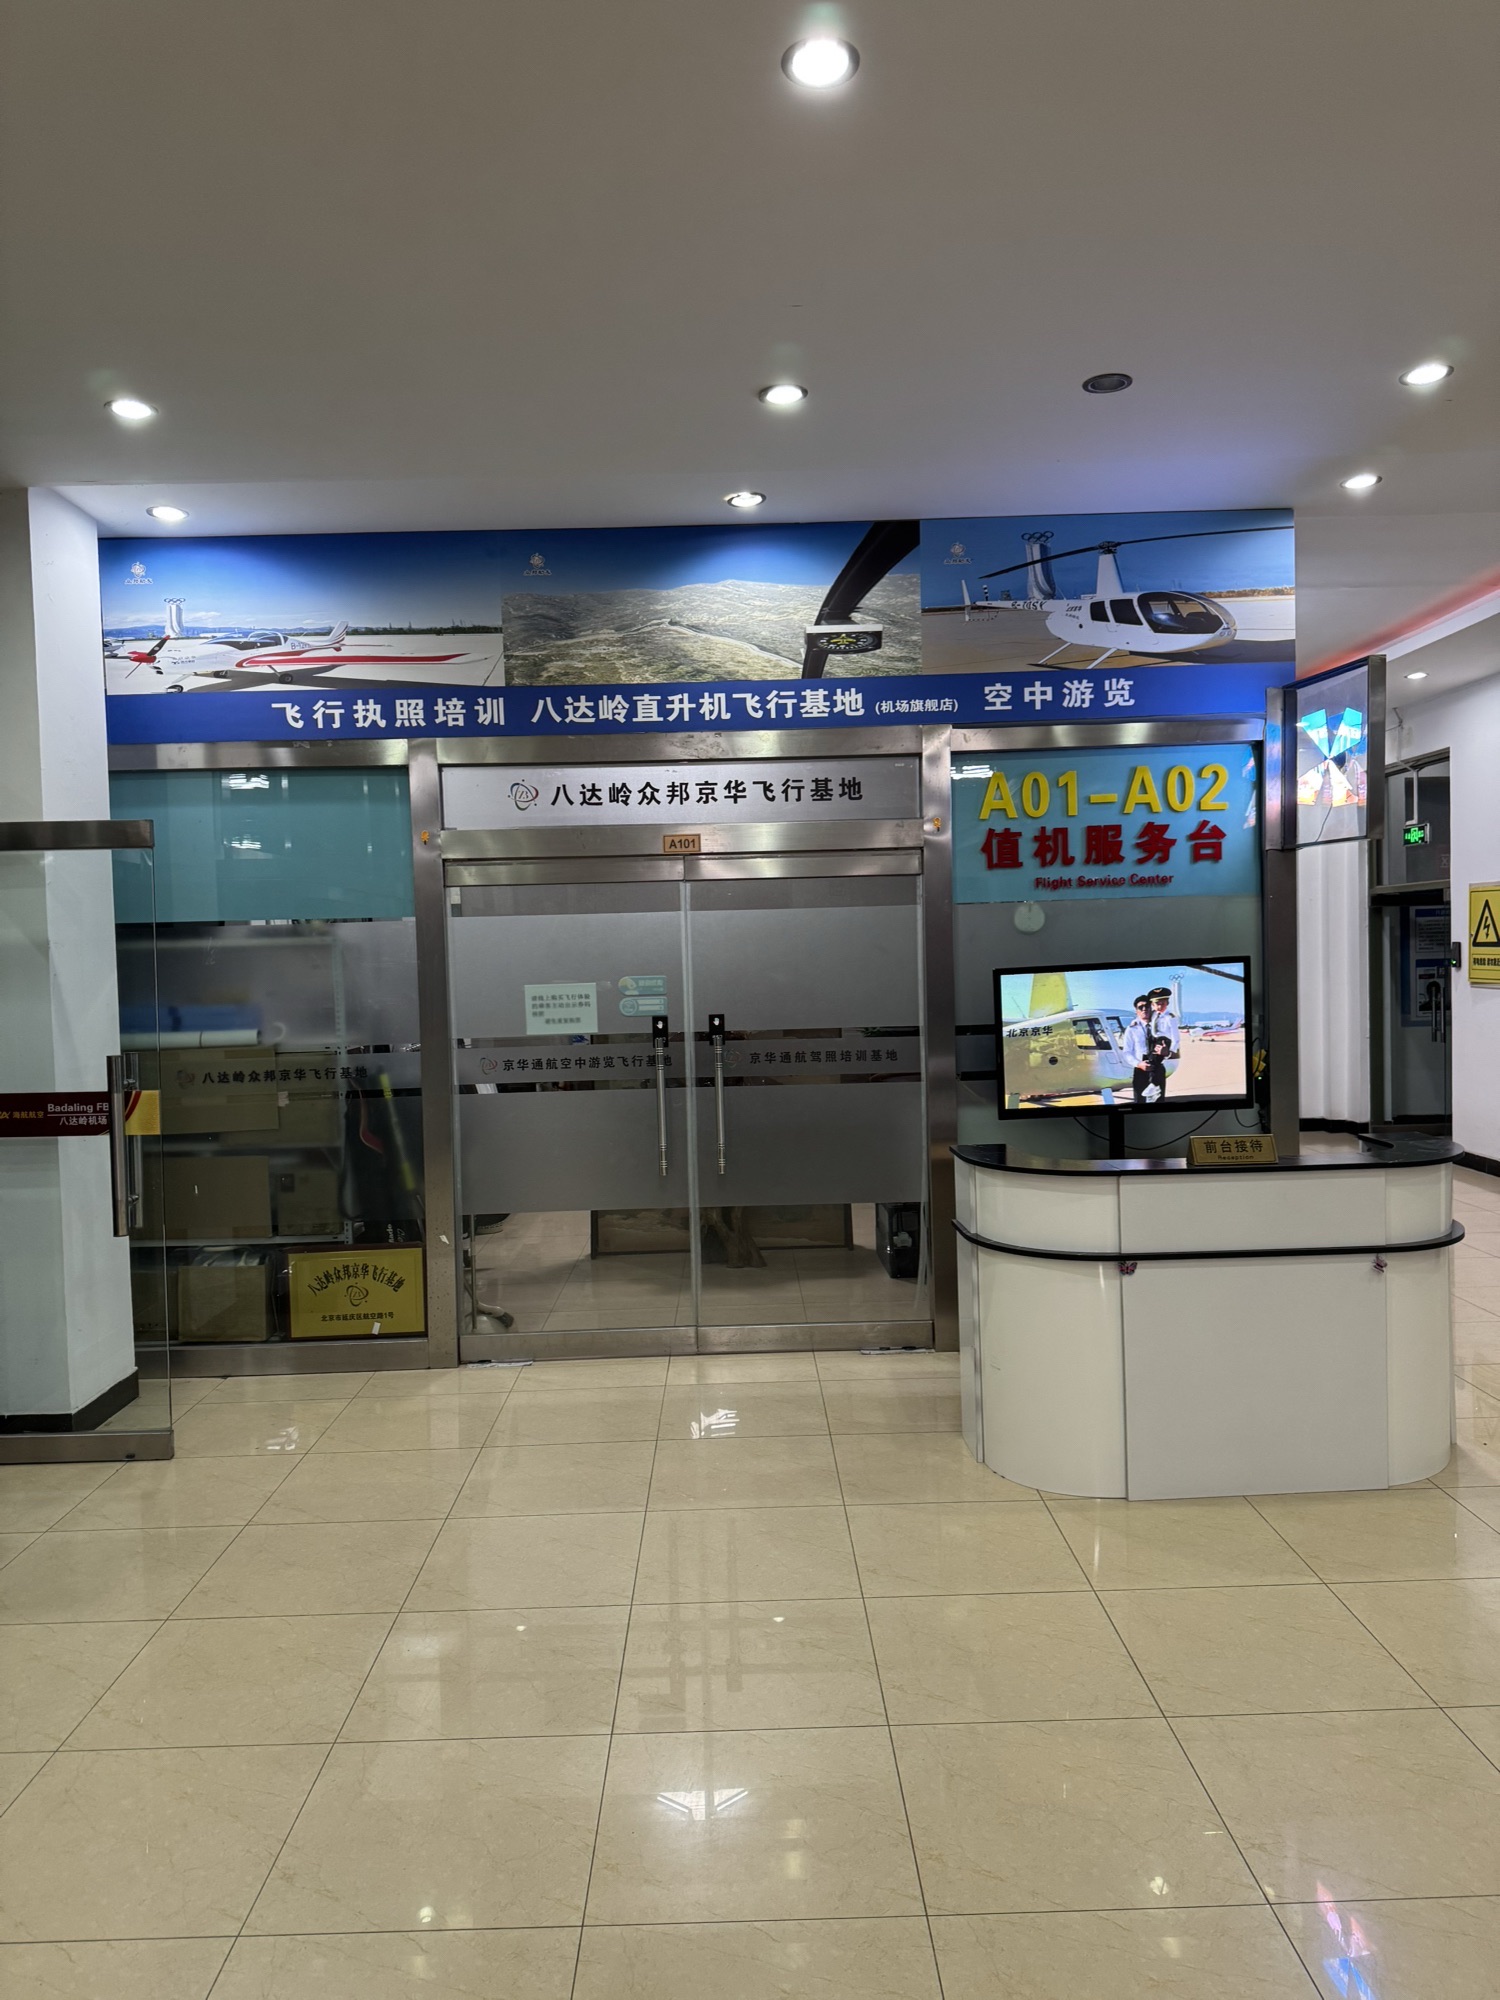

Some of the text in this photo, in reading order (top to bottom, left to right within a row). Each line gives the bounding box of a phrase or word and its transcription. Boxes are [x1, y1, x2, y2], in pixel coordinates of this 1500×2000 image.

[271, 678, 1136, 729] 飞行执照培训 八达岭直升机飞行基地 (机场旗舰店) 空中游览
[550, 776, 864, 807] 八达岭众邦京华飞行基地
[978, 763, 1229, 821] A01-A02
[669, 838, 696, 849] A101
[979, 819, 1227, 870] 值机服务台
[1035, 872, 1174, 889] Flight Service Center
[1006, 1026, 1053, 1038] 北京京华
[750, 1049, 898, 1064] 京华通航驾照培训基地
[202, 1066, 368, 1084] 八达岭众邦京华飞行基地
[47, 1103, 94, 1113] Badaling
[59, 1115, 108, 1126] 八达岭机场
[1204, 1140, 1263, 1154] 前台接待
[307, 1263, 406, 1297] 八达岭众邦京华飞行基地
